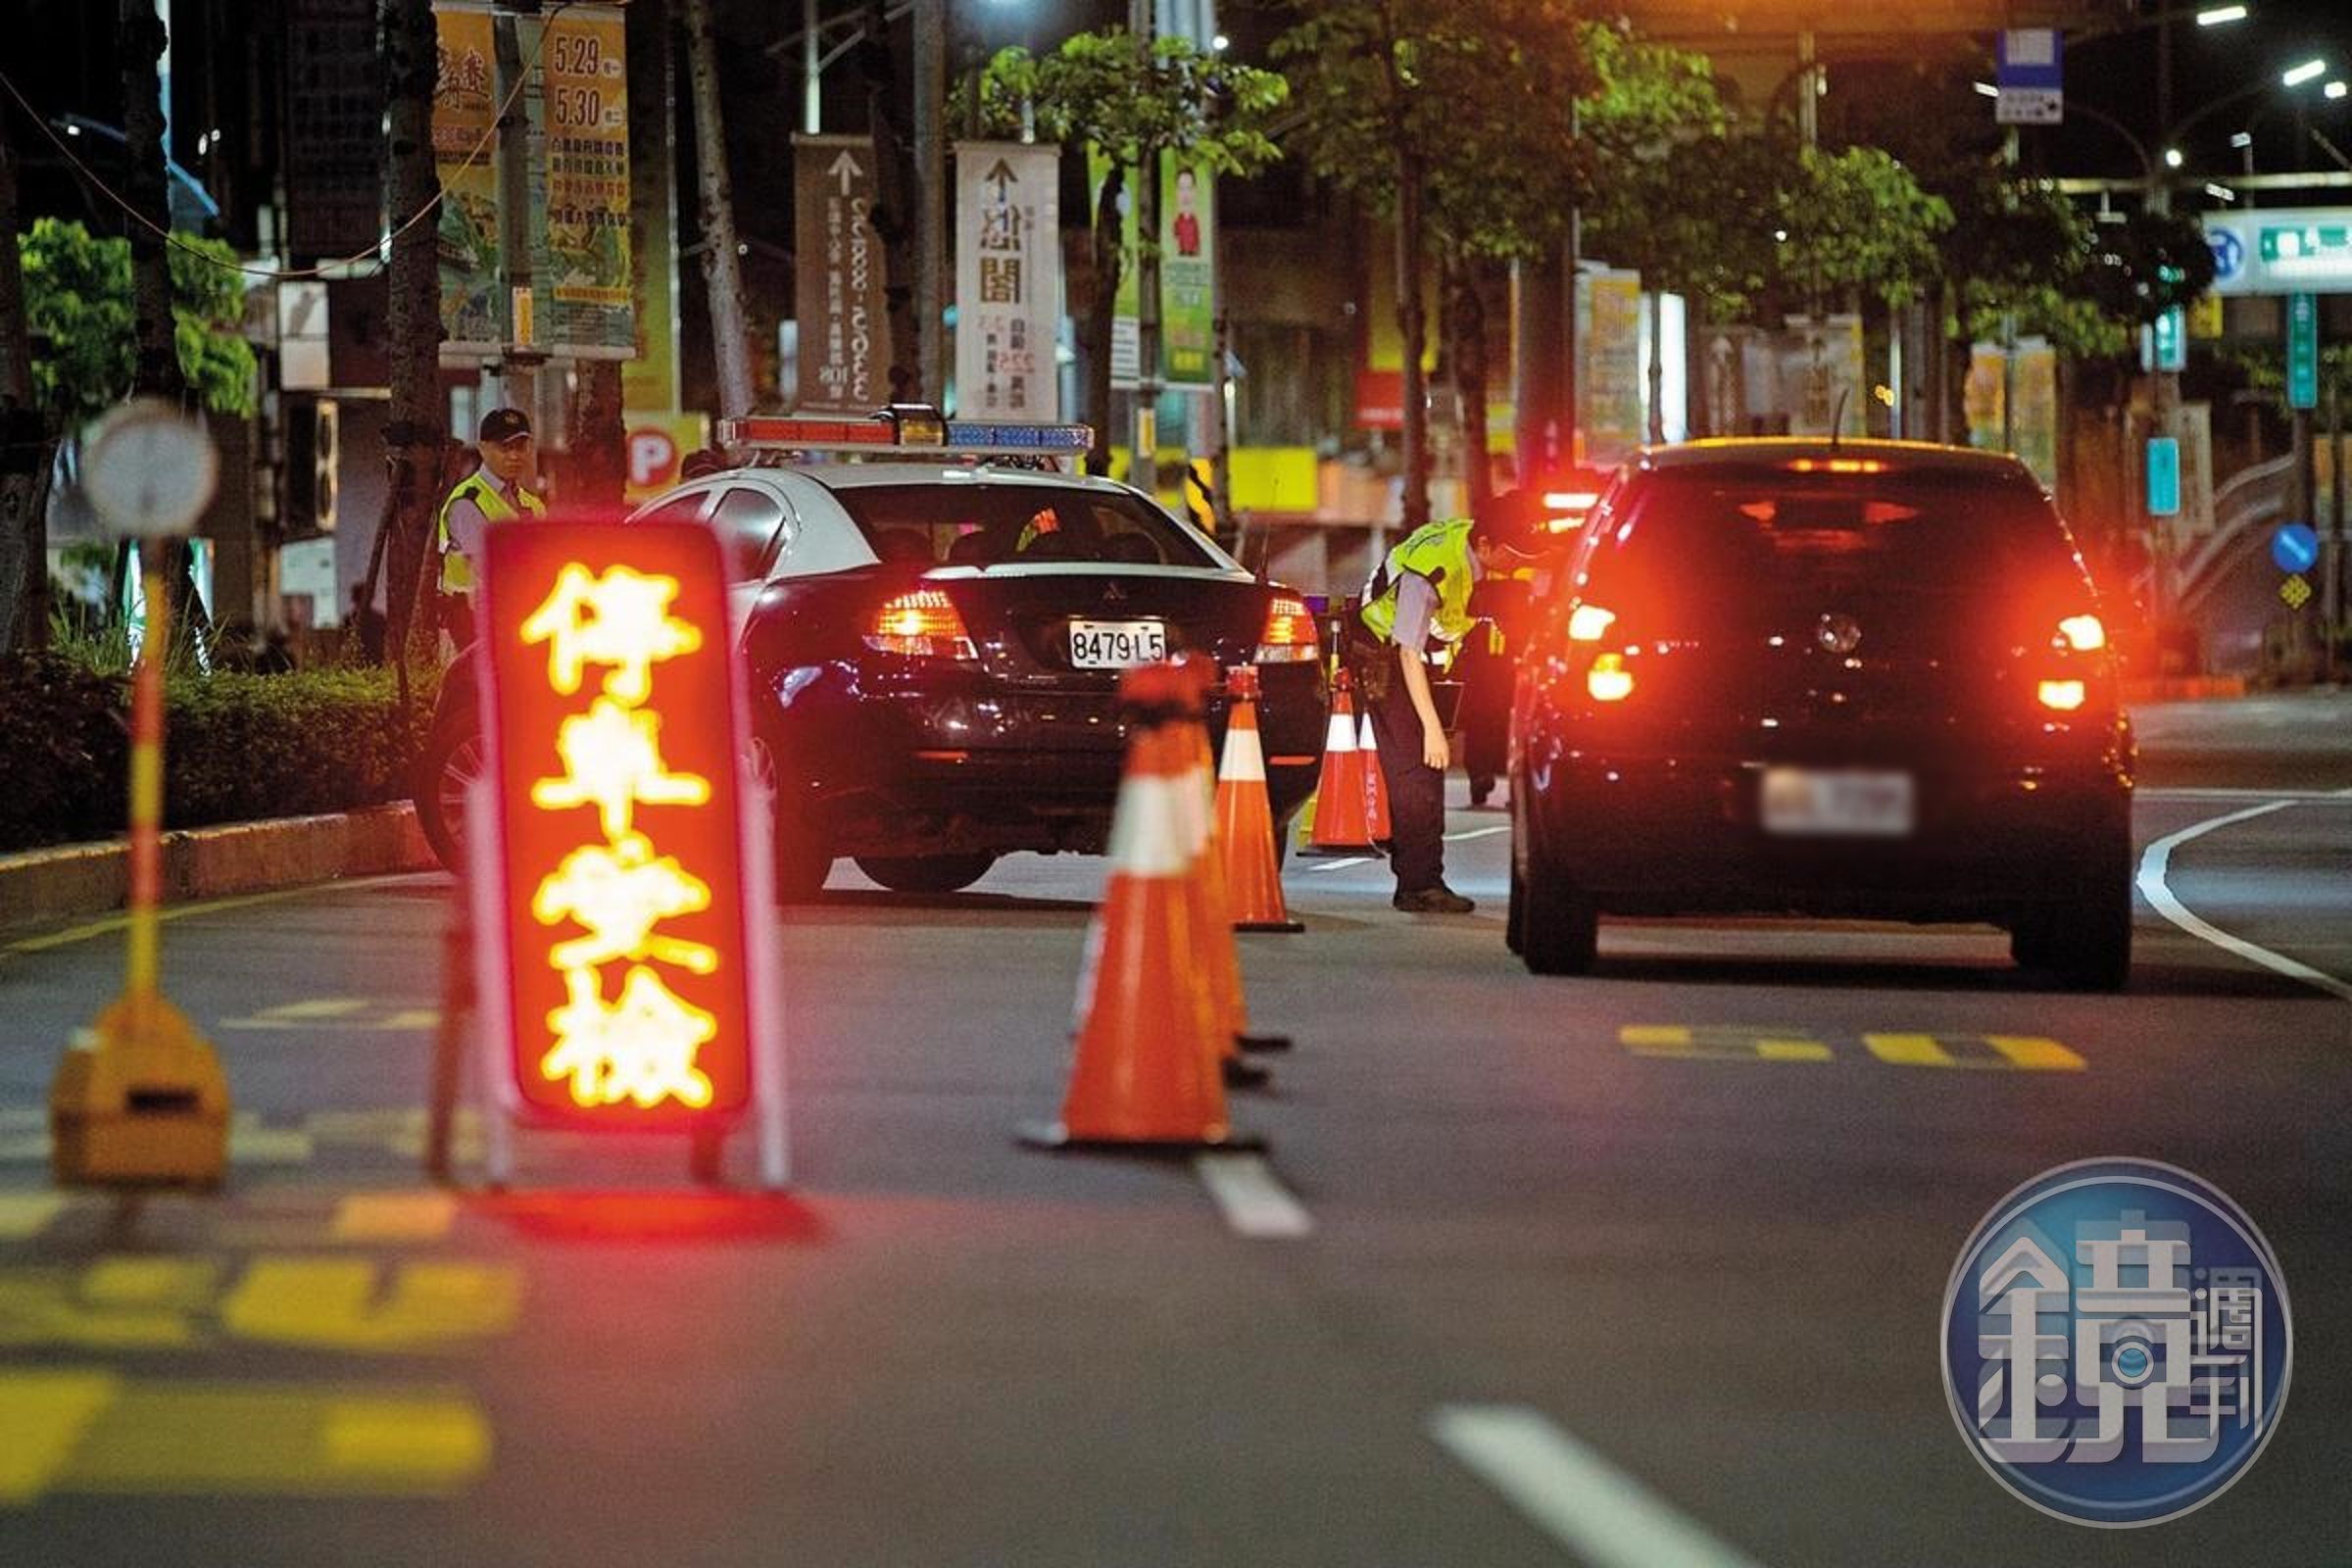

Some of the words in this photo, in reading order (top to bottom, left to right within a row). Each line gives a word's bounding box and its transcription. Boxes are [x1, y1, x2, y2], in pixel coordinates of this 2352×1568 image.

[555, 36, 600, 74] 5.29
[555, 88, 601, 126] 5.30
[631, 434, 672, 484] P
[519, 561, 718, 1107] 停車受檢
